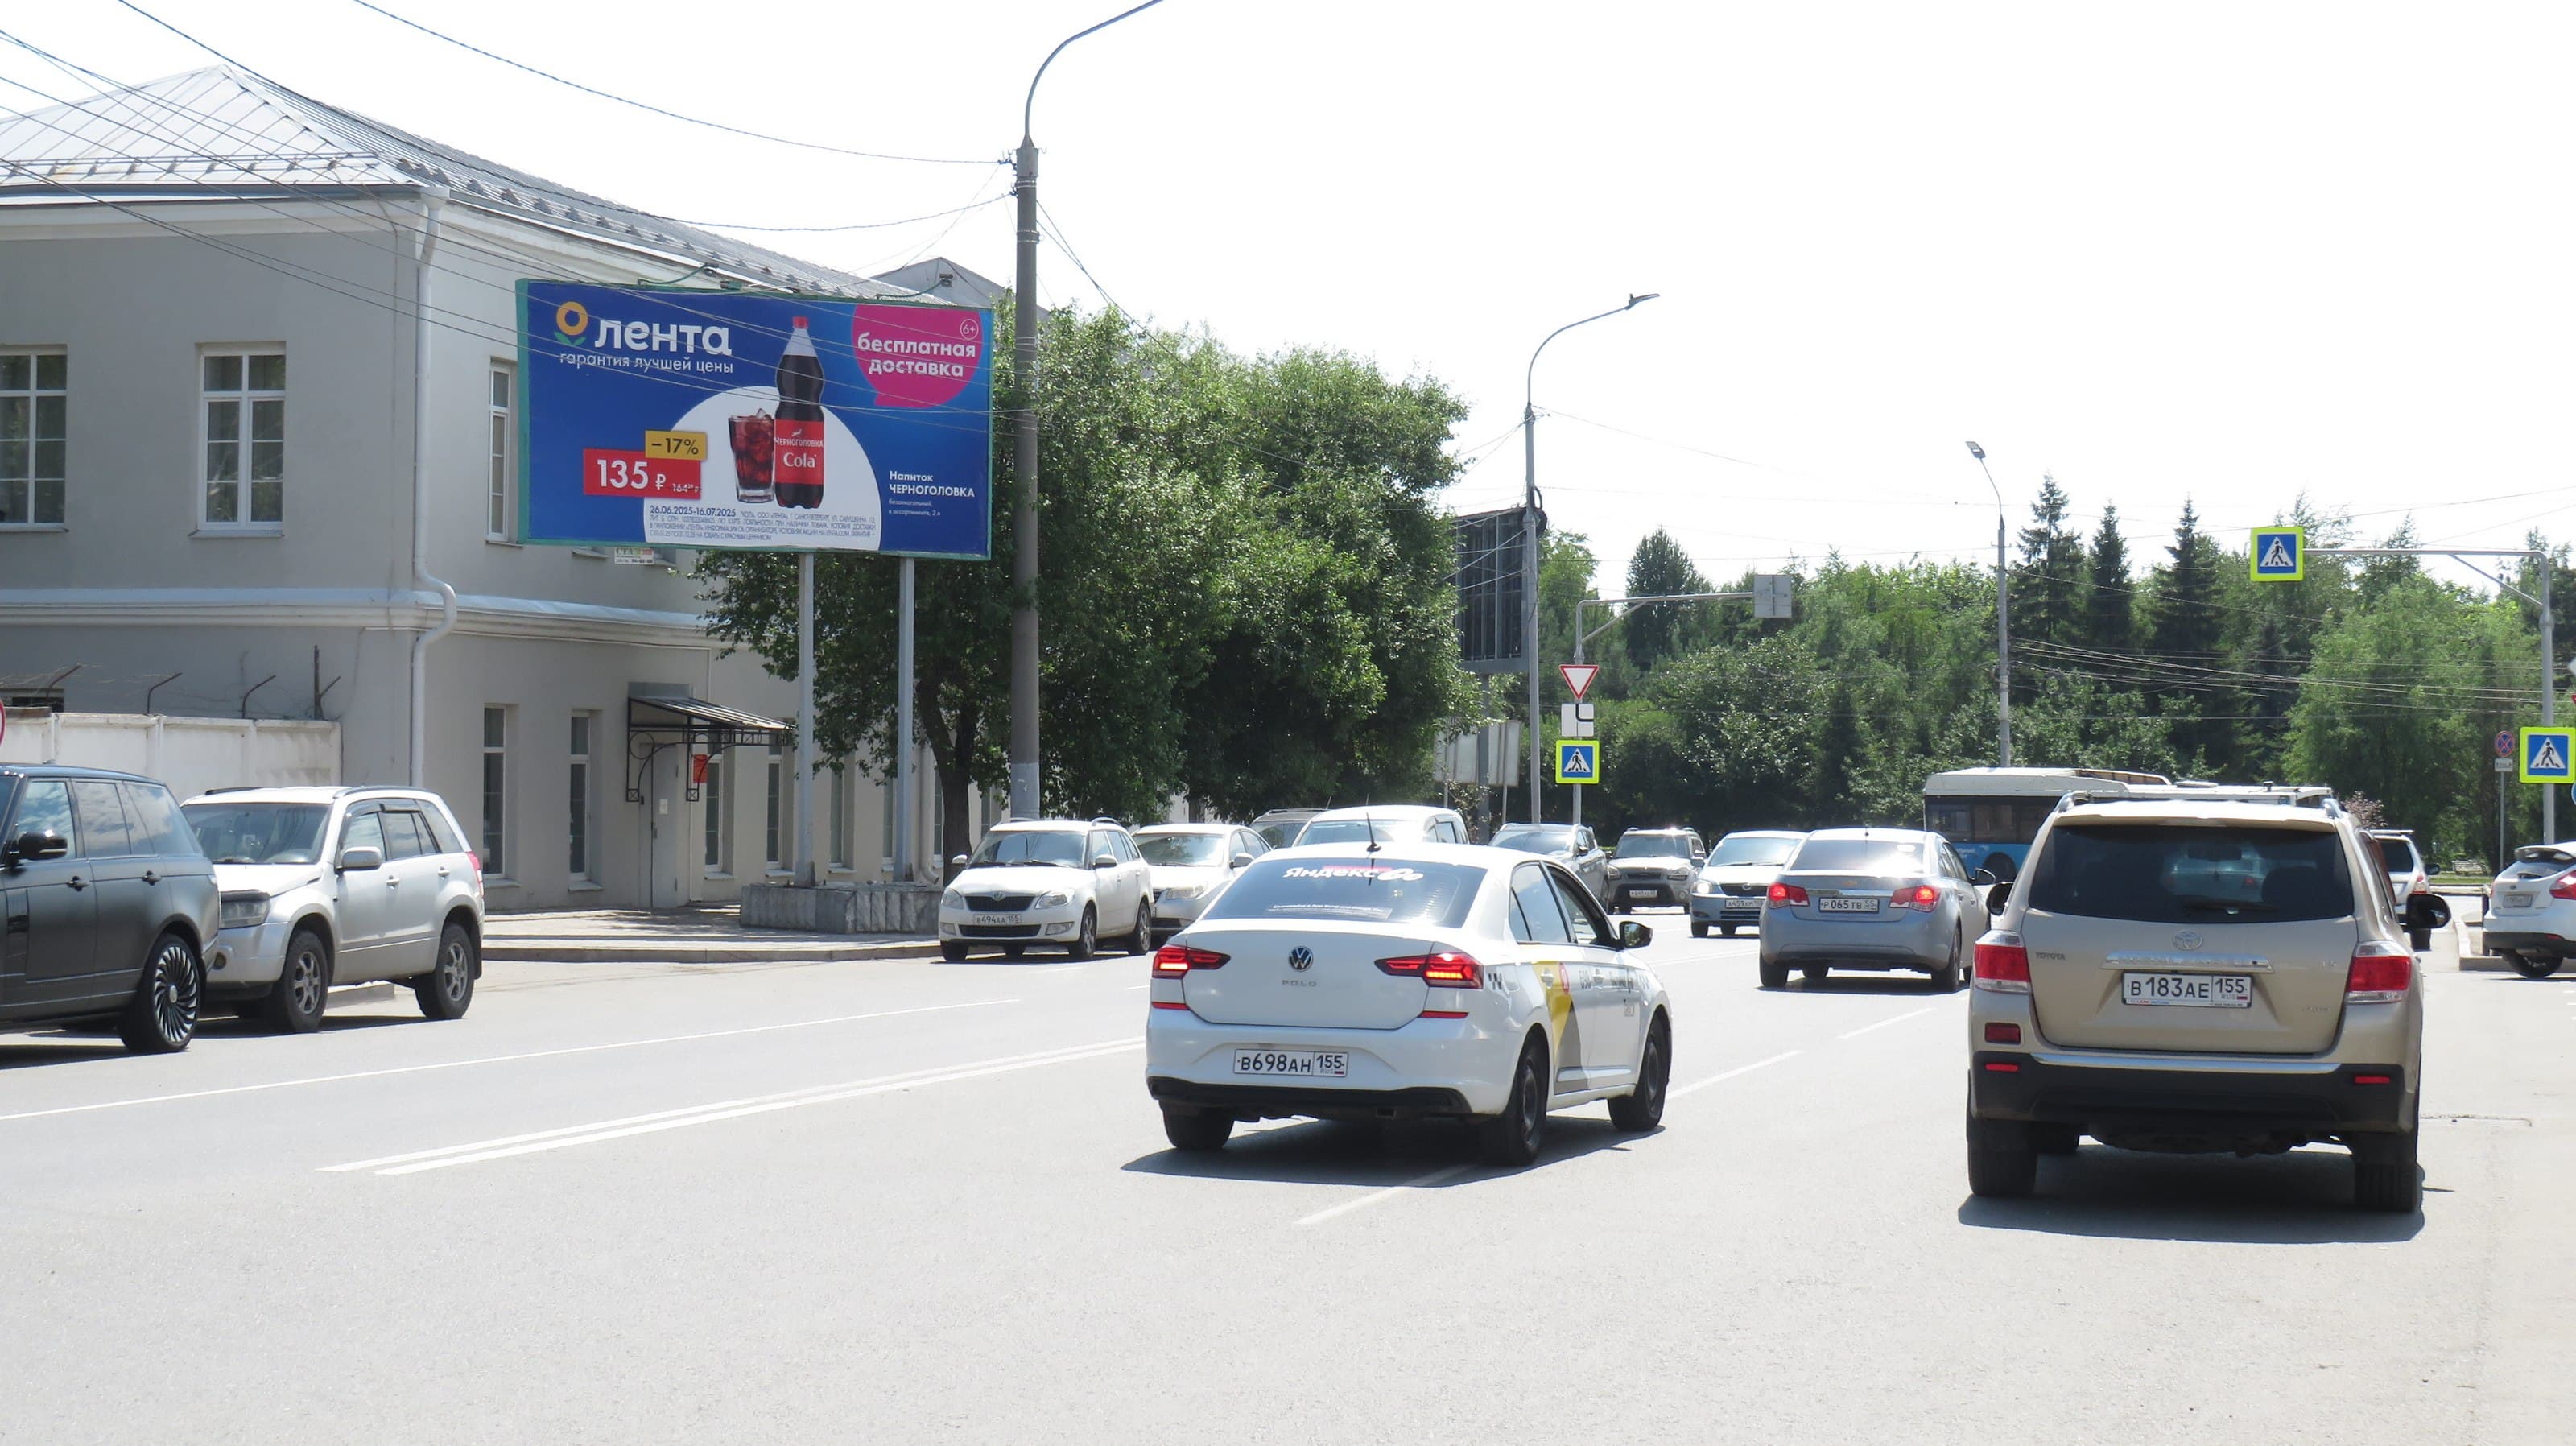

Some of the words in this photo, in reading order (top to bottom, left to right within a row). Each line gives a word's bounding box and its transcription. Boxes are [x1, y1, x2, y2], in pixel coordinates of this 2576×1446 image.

[962, 324, 976, 334] 6+
[595, 320, 733, 356] лента
[857, 332, 976, 357] бесплатная
[560, 353, 630, 369] гарантия
[634, 357, 691, 373] лучшей
[696, 361, 733, 374] цены
[869, 359, 964, 377] доставка
[783, 452, 815, 468] Cola
[597, 459, 649, 490] 135
[890, 470, 934, 481] Напиток
[889, 483, 976, 498] ЧЕРНОГОЛОВКА
[650, 505, 737, 517] 26.06.2025-16.07.2025
[1282, 867, 1378, 878] Яндекс
[2035, 952, 2066, 960] TOYOTA
[2130, 977, 2210, 998] В183АЕ
[2215, 978, 2244, 994] 155
[1241, 1053, 1312, 1072] В698АН
[1316, 1054, 1343, 1069] 155
